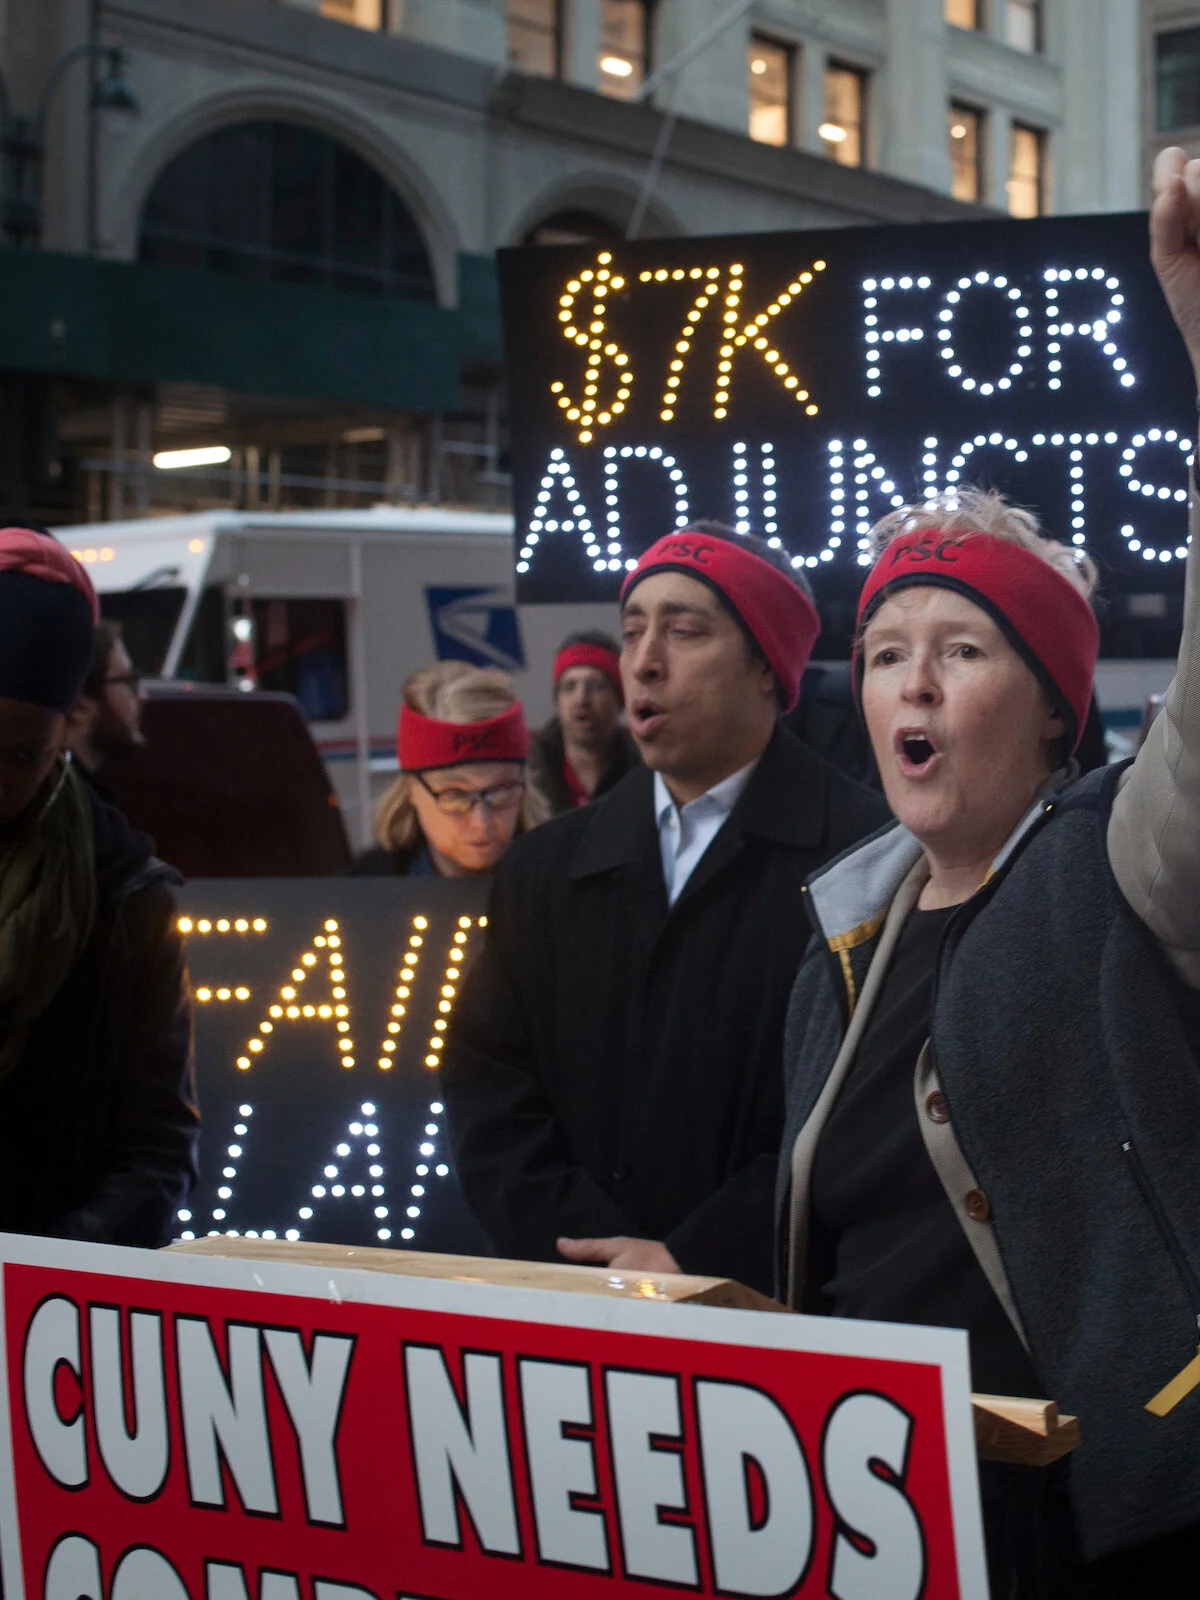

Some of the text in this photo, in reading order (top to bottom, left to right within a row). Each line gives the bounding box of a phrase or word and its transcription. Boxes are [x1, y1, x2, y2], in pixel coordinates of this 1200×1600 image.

[550, 251, 1136, 444] $7K FOR
[889, 538, 963, 568] PSC
[22, 1291, 928, 1600] CUNY NEEDS
